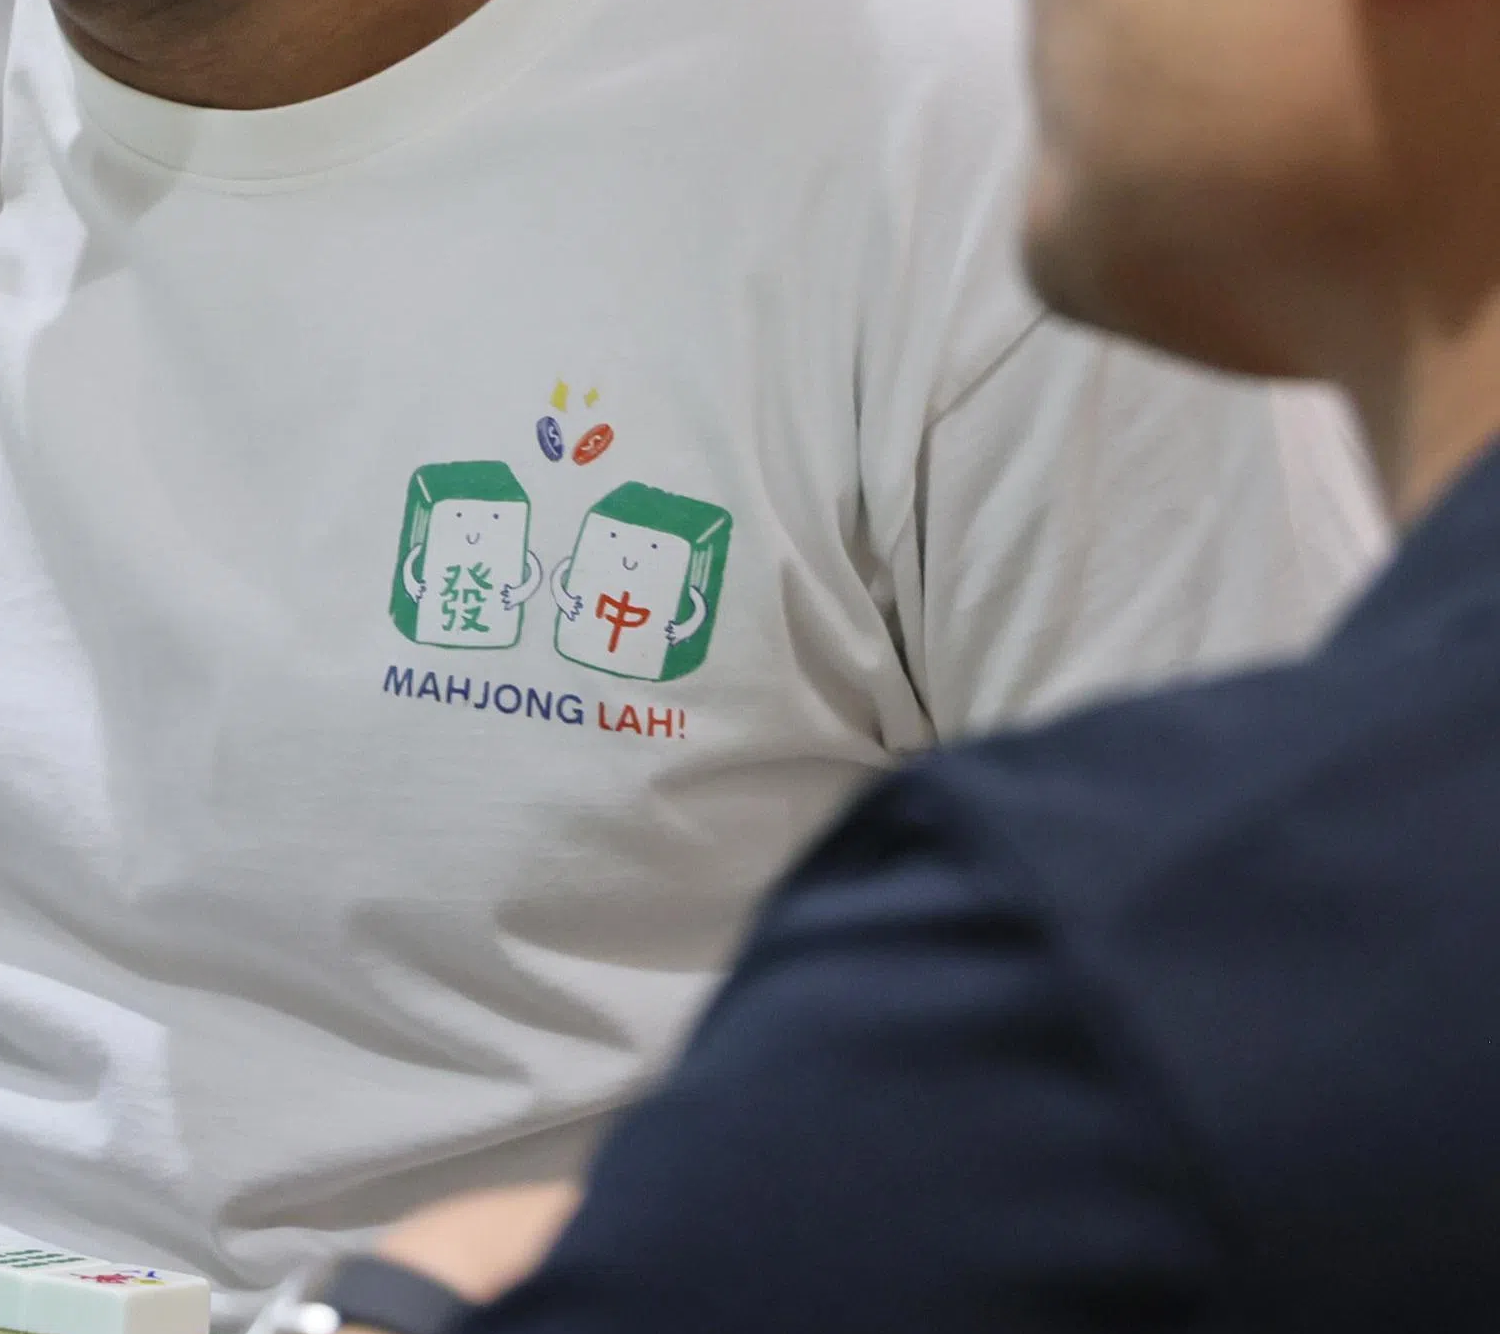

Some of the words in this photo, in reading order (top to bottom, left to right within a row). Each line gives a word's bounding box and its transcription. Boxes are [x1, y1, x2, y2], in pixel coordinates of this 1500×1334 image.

[440, 561, 493, 633] 發
[595, 590, 652, 653] 中
[383, 665, 584, 725] MAHJONG
[598, 701, 685, 739] LAH!
